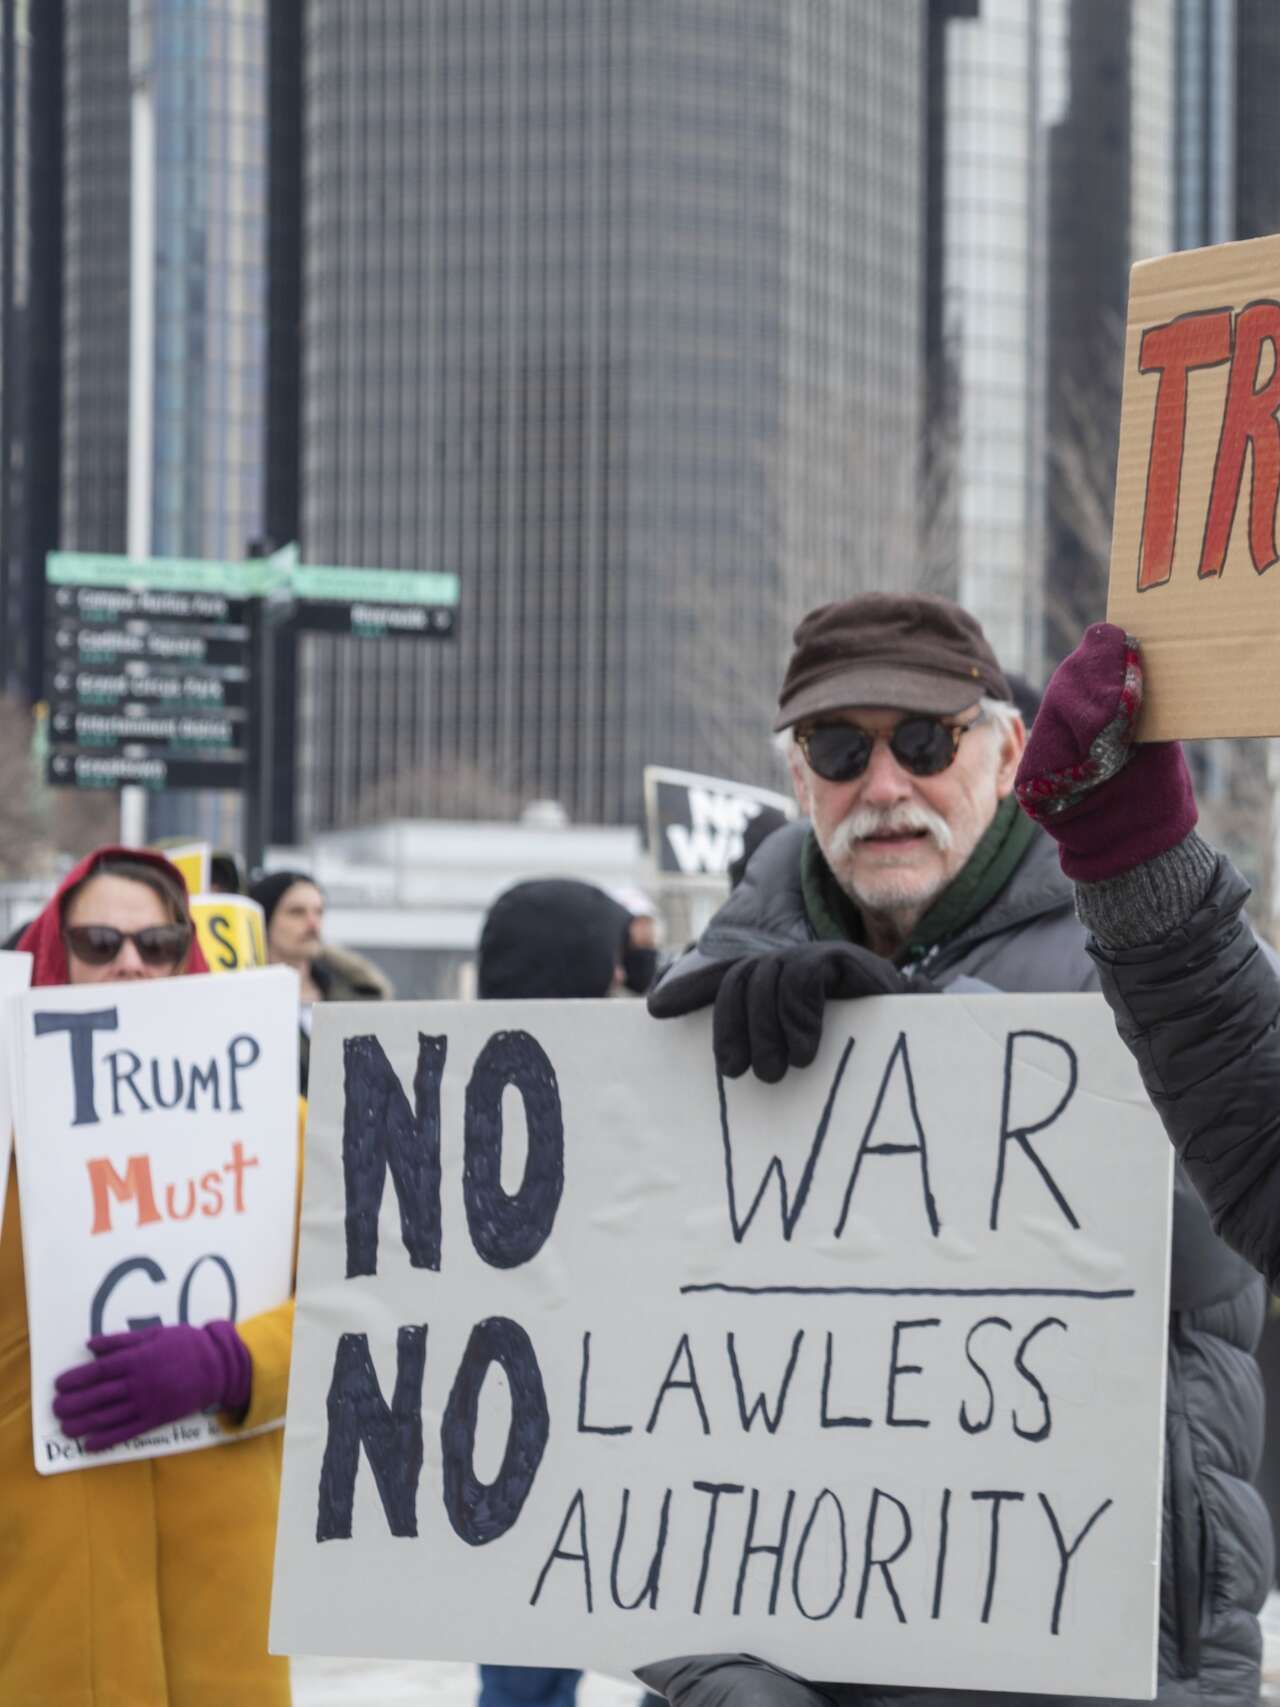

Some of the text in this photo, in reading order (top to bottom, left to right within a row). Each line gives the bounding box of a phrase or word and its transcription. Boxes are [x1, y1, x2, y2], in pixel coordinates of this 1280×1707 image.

[33, 1006, 261, 1127] TRUMP
[342, 1029, 1080, 1279] NO WAR
[316, 1315, 1068, 1547] NO LAWLESS
[530, 1480, 1113, 1635] AUTHORITY
